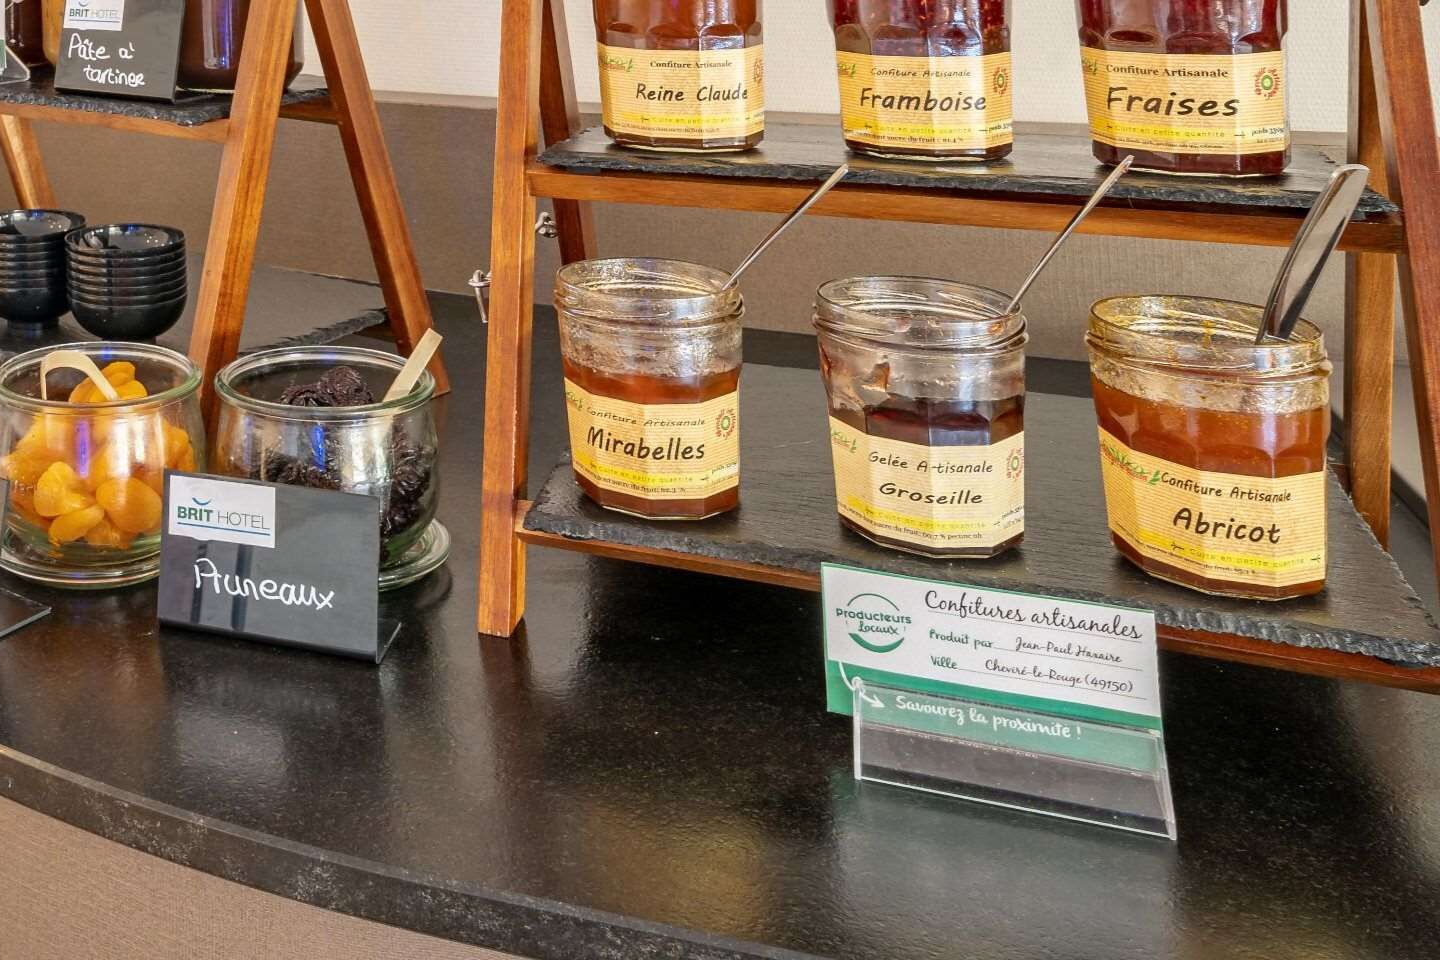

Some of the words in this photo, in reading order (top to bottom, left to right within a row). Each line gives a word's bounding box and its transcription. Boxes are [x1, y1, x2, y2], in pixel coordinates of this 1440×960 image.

[69, 8, 90, 17] BRIT
[68, 33, 110, 60] Pâte
[119, 42, 135, 59] à
[649, 60, 692, 69] Confiture
[871, 67, 919, 78] Confiture
[922, 68, 971, 78] Artisanale
[1106, 64, 1160, 76] Confiture
[1163, 67, 1229, 78] Artisanale
[636, 83, 685, 101] Reine
[696, 82, 748, 101] Claude
[860, 87, 987, 111] Framboise
[1106, 86, 1241, 116] Fraises
[587, 406, 637, 425] Confiture
[644, 418, 705, 427] Artisanale
[587, 425, 705, 461] Mirabelles
[868, 451, 908, 468] Gelée
[879, 482, 983, 504] Groseille
[1160, 471, 1222, 497] Confiture
[1229, 486, 1292, 502] Artisanale
[177, 506, 213, 523] BRIT
[216, 511, 271, 530] HOTEL
[1172, 507, 1281, 544] Abricot
[193, 557, 335, 610] Pruneaux
[835, 607, 912, 624] Producteurs
[924, 589, 1026, 622] Confitures
[1030, 607, 1143, 639] artisanales
[928, 628, 969, 644] Produit
[973, 637, 993, 649] par
[1015, 636, 1073, 656] Jean-Paul
[930, 655, 959, 670] Ville
[1085, 673, 1133, 693] (49150)
[895, 695, 966, 726] Savourez
[968, 708, 989, 724] la
